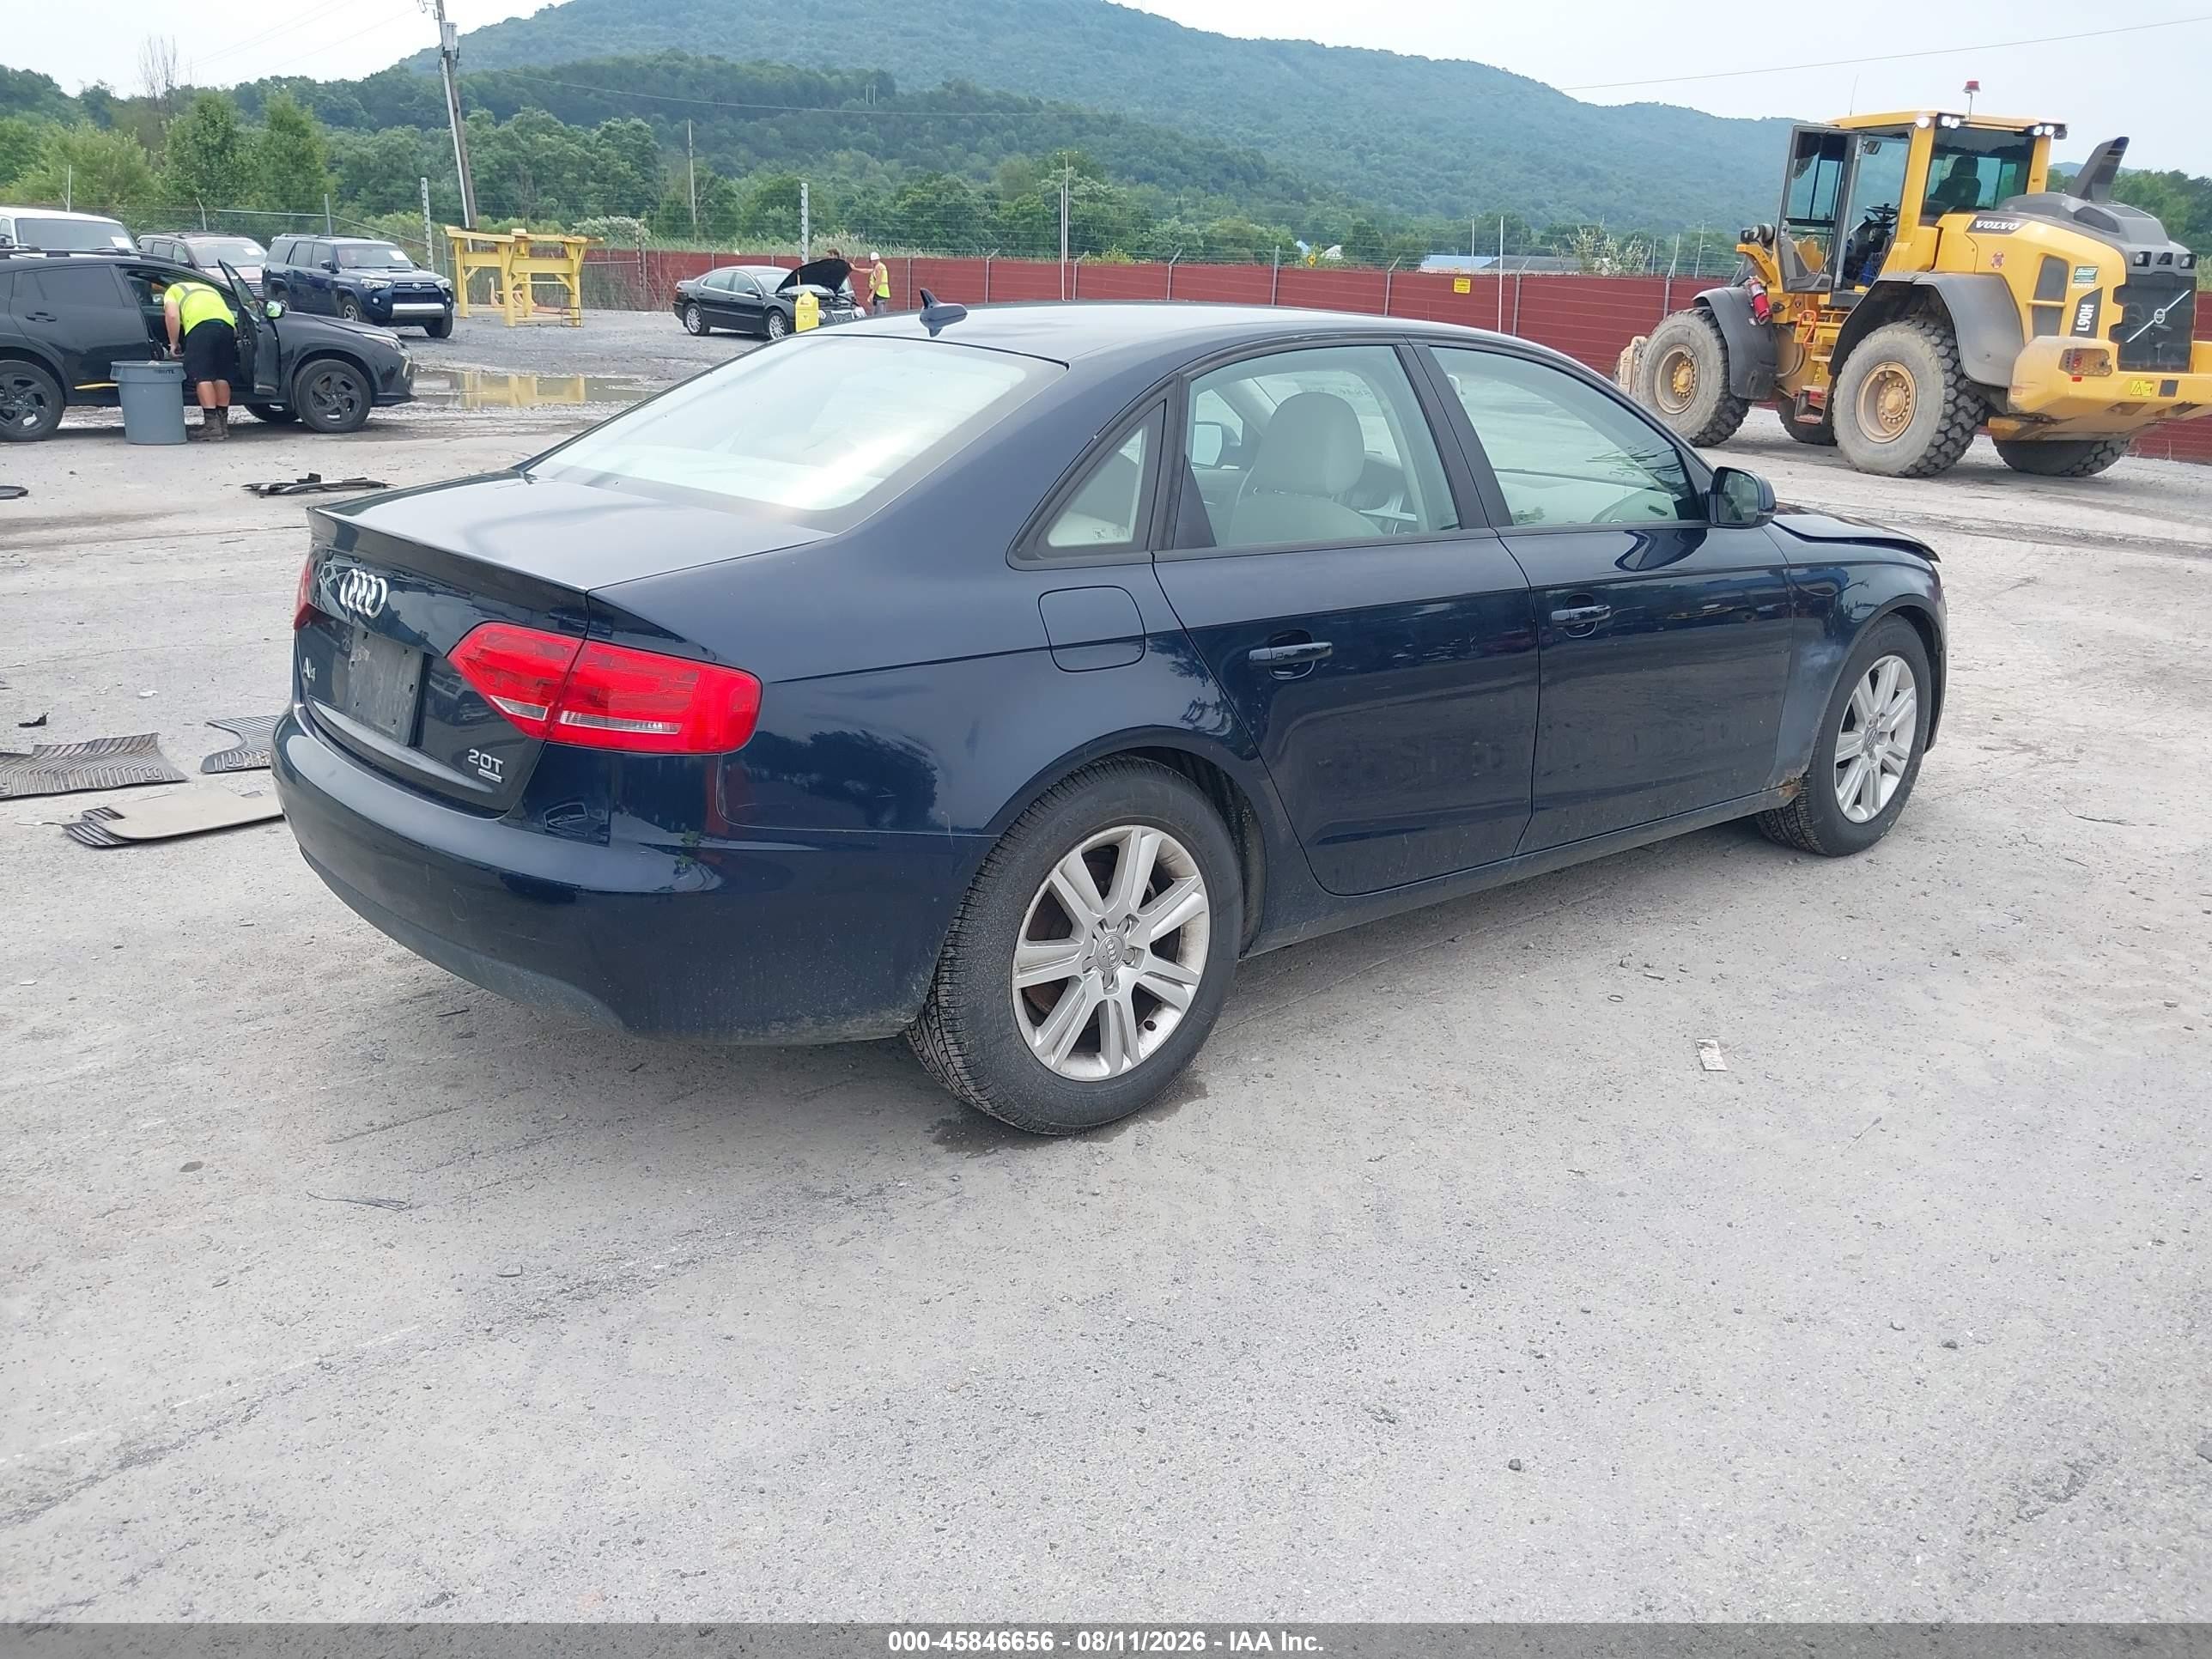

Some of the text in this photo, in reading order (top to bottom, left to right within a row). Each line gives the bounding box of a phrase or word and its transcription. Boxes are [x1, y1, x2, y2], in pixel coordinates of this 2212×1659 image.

[1975, 220, 2021, 231] VOLVO
[2075, 304, 2095, 331] L90H
[302, 657, 316, 682] A4
